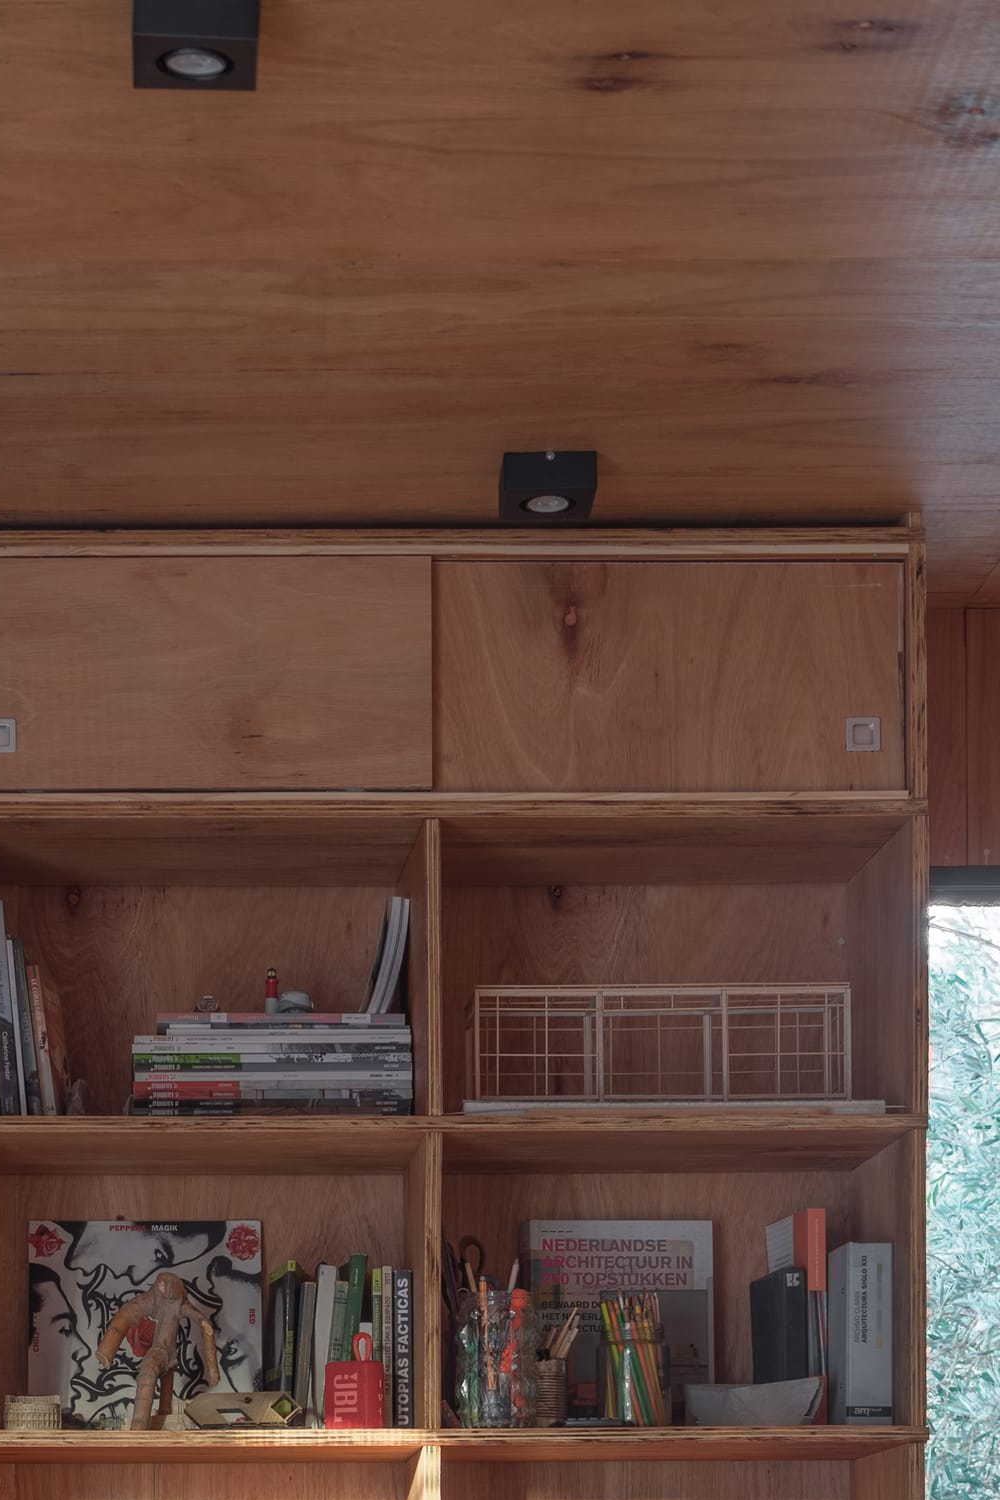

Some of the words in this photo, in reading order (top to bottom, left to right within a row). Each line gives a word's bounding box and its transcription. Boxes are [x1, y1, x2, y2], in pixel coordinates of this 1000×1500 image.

[1, 1031, 10, 1060] Catherine
[3, 1062, 12, 1081] Foster
[151, 1224, 178, 1232] MAGIK
[541, 1238, 668, 1252] NEDERLANDSE
[541, 1255, 672, 1269] ARCHITECTUUR
[675, 1255, 693, 1269] IN
[573, 1272, 688, 1286] TOPSTUKKEN
[248, 1307, 256, 1325] RED
[397, 1277, 410, 1353] FACTICAS
[542, 1312, 560, 1320] HET
[333, 1371, 359, 1424] JBL
[397, 1358, 410, 1426] UTOPIAS
[853, 1406, 870, 1417] arq
